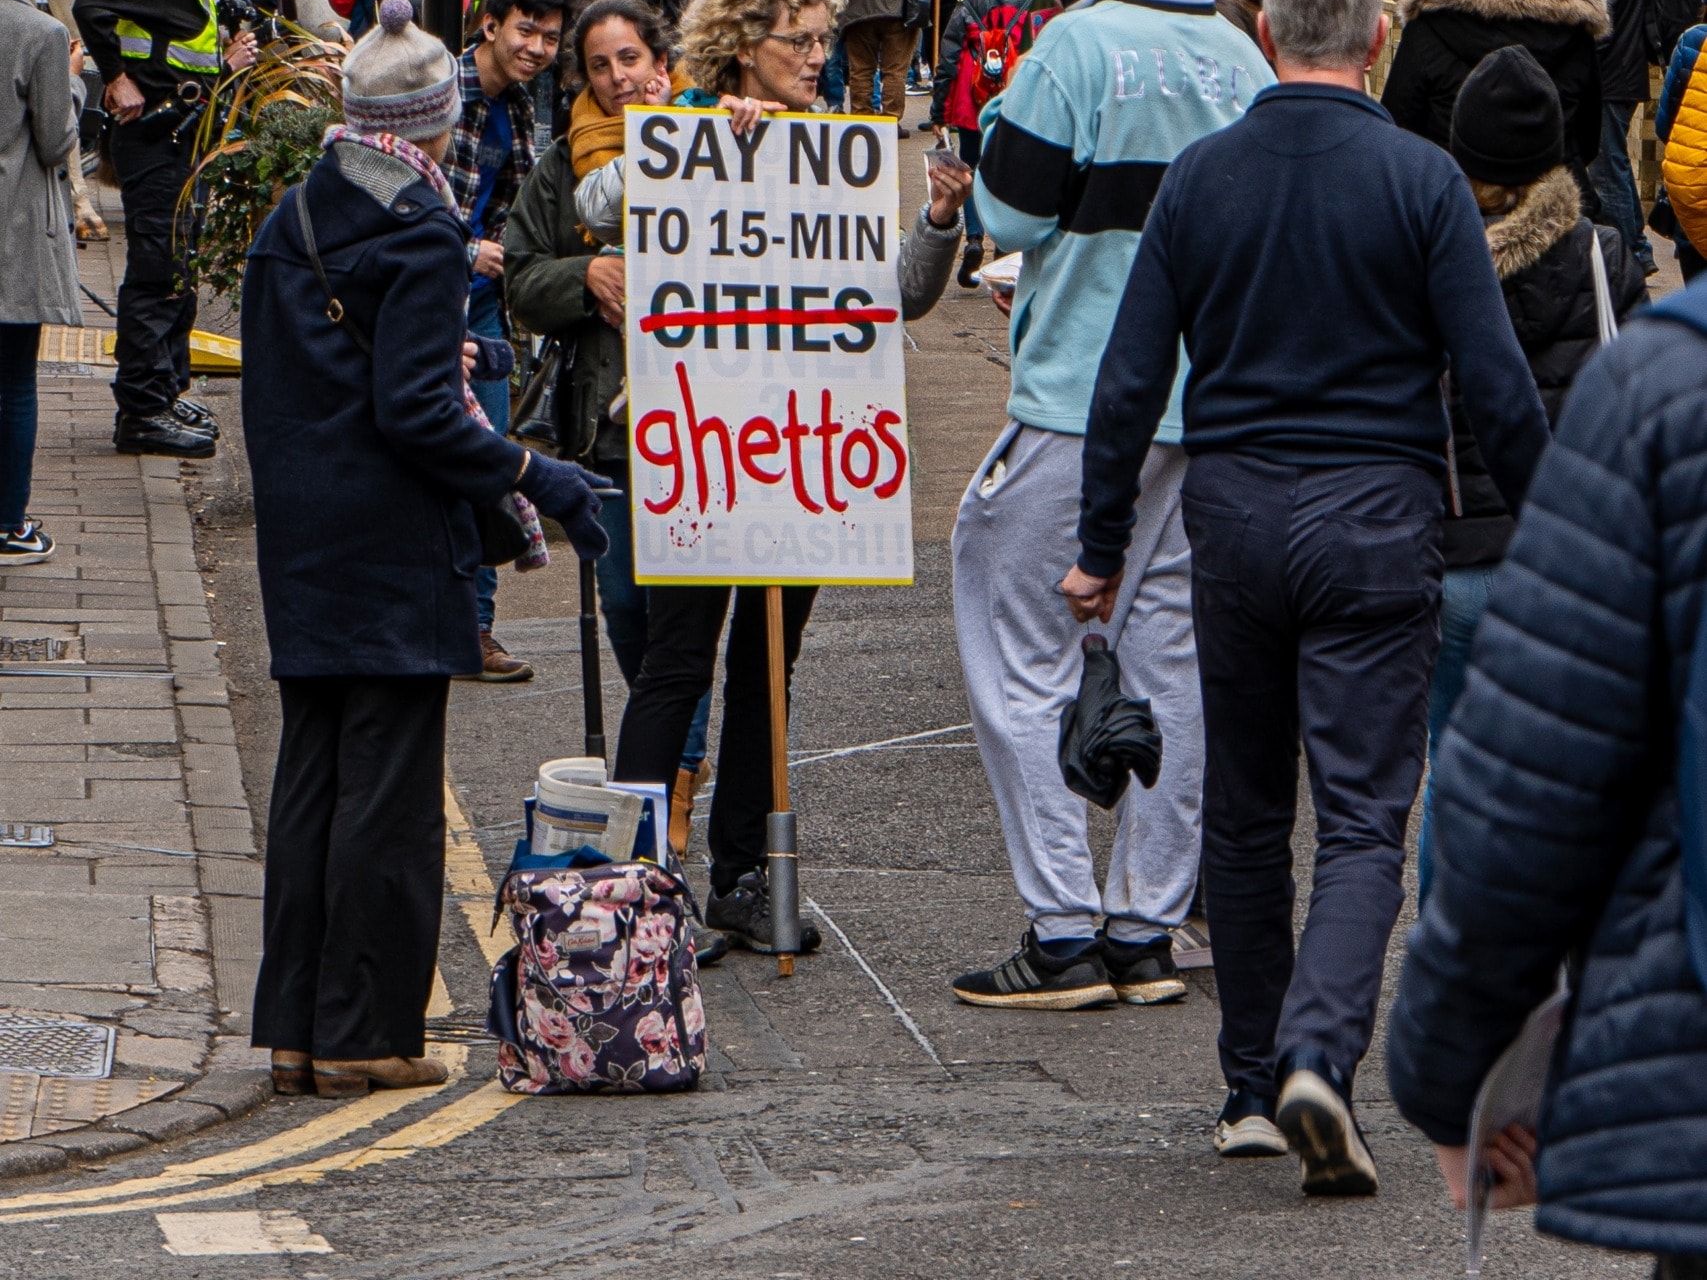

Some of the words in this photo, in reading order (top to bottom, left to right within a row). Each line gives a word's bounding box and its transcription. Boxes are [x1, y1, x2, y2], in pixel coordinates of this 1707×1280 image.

[637, 114, 770, 183] SAY
[789, 121, 882, 188] NO
[629, 205, 690, 255] TO
[709, 208, 886, 262] 15-MIN
[649, 280, 878, 354] CITIES
[635, 361, 907, 516] ghettos
